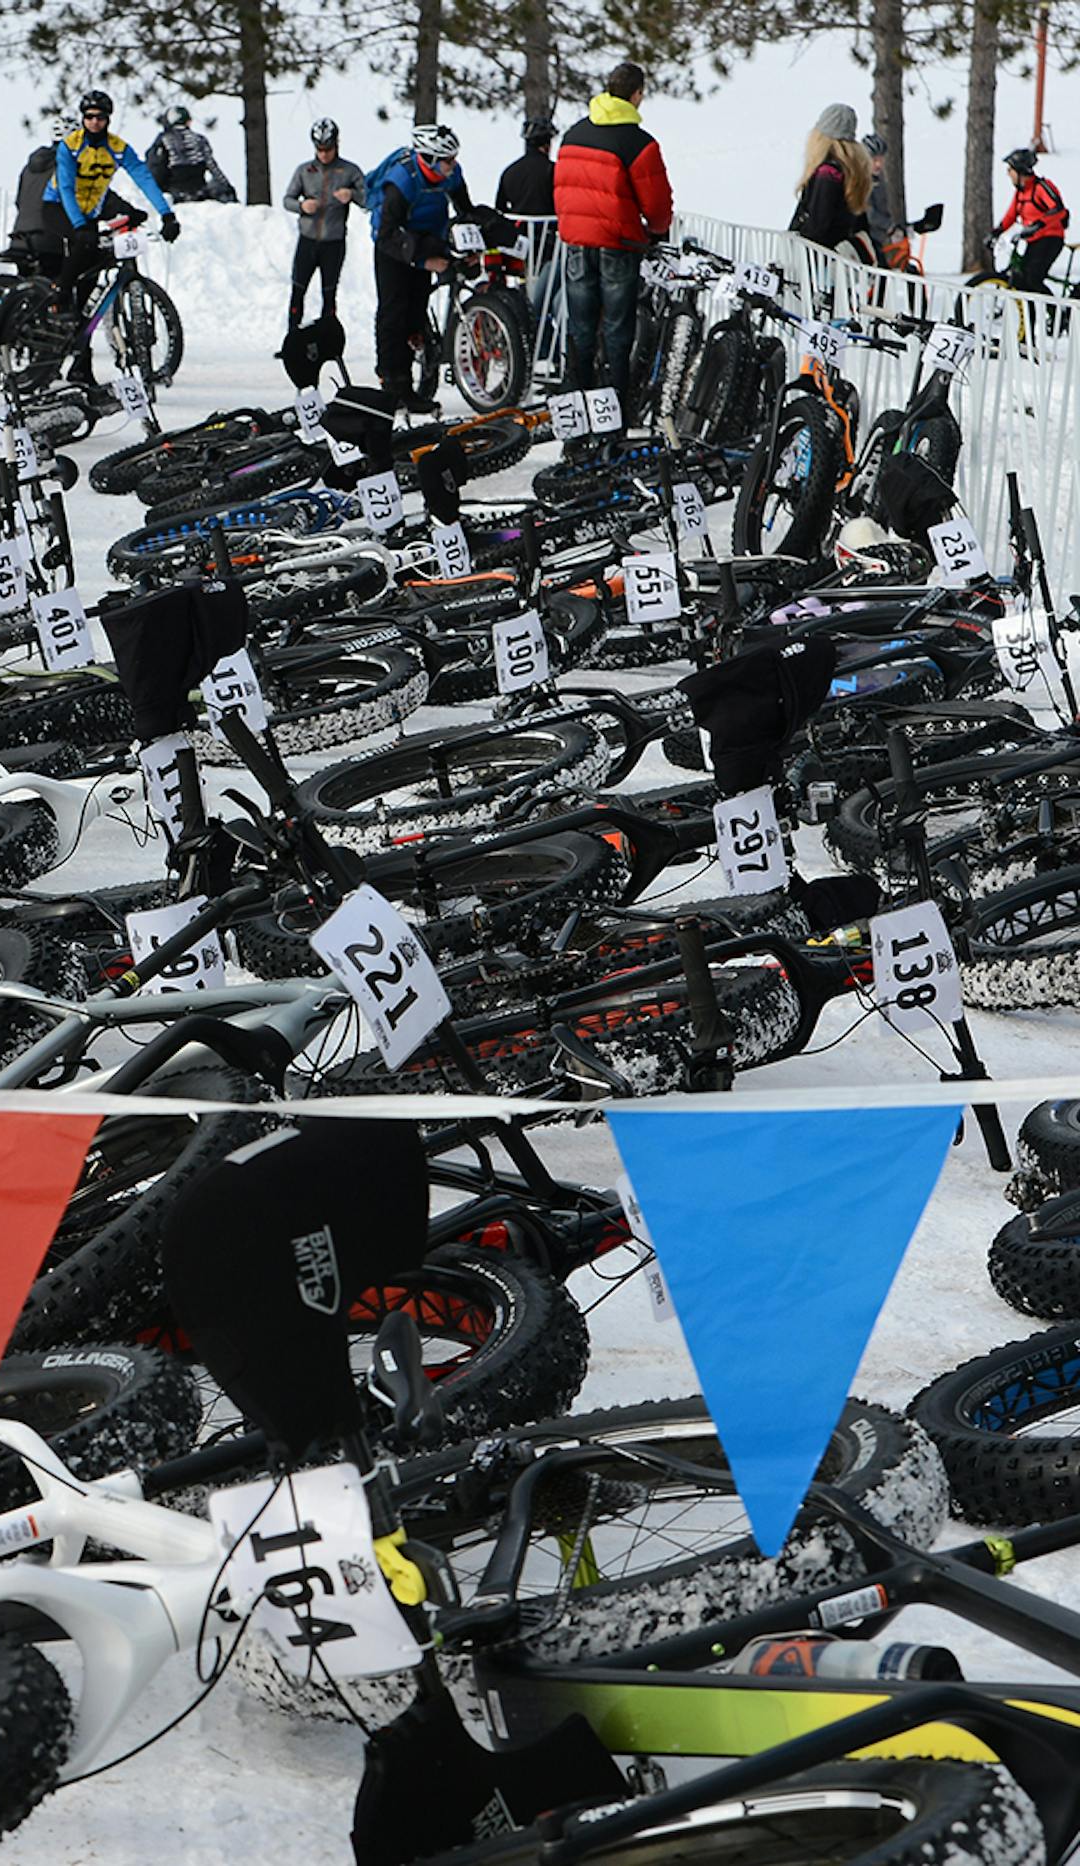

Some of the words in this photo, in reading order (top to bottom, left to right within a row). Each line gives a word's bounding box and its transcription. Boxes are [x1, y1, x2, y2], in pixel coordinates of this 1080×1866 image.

[124, 239, 139, 252] 30
[743, 269, 771, 288] 419
[809, 334, 839, 358] 495
[302, 400, 322, 430] 351
[561, 402, 575, 428] 177
[592, 395, 610, 425] 256
[367, 483, 392, 521] 273
[679, 494, 702, 528] 362
[441, 535, 465, 576] 302
[940, 531, 971, 572] 234
[634, 566, 663, 609] 551
[46, 607, 80, 656] 401
[505, 630, 536, 678] 190
[729, 809, 769, 873] 297
[344, 923, 419, 1031] 221
[890, 930, 937, 1010] 138
[291, 1236, 326, 1301] MITTS
[308, 1230, 332, 1279] BAR
[250, 1520, 357, 1647] 164
